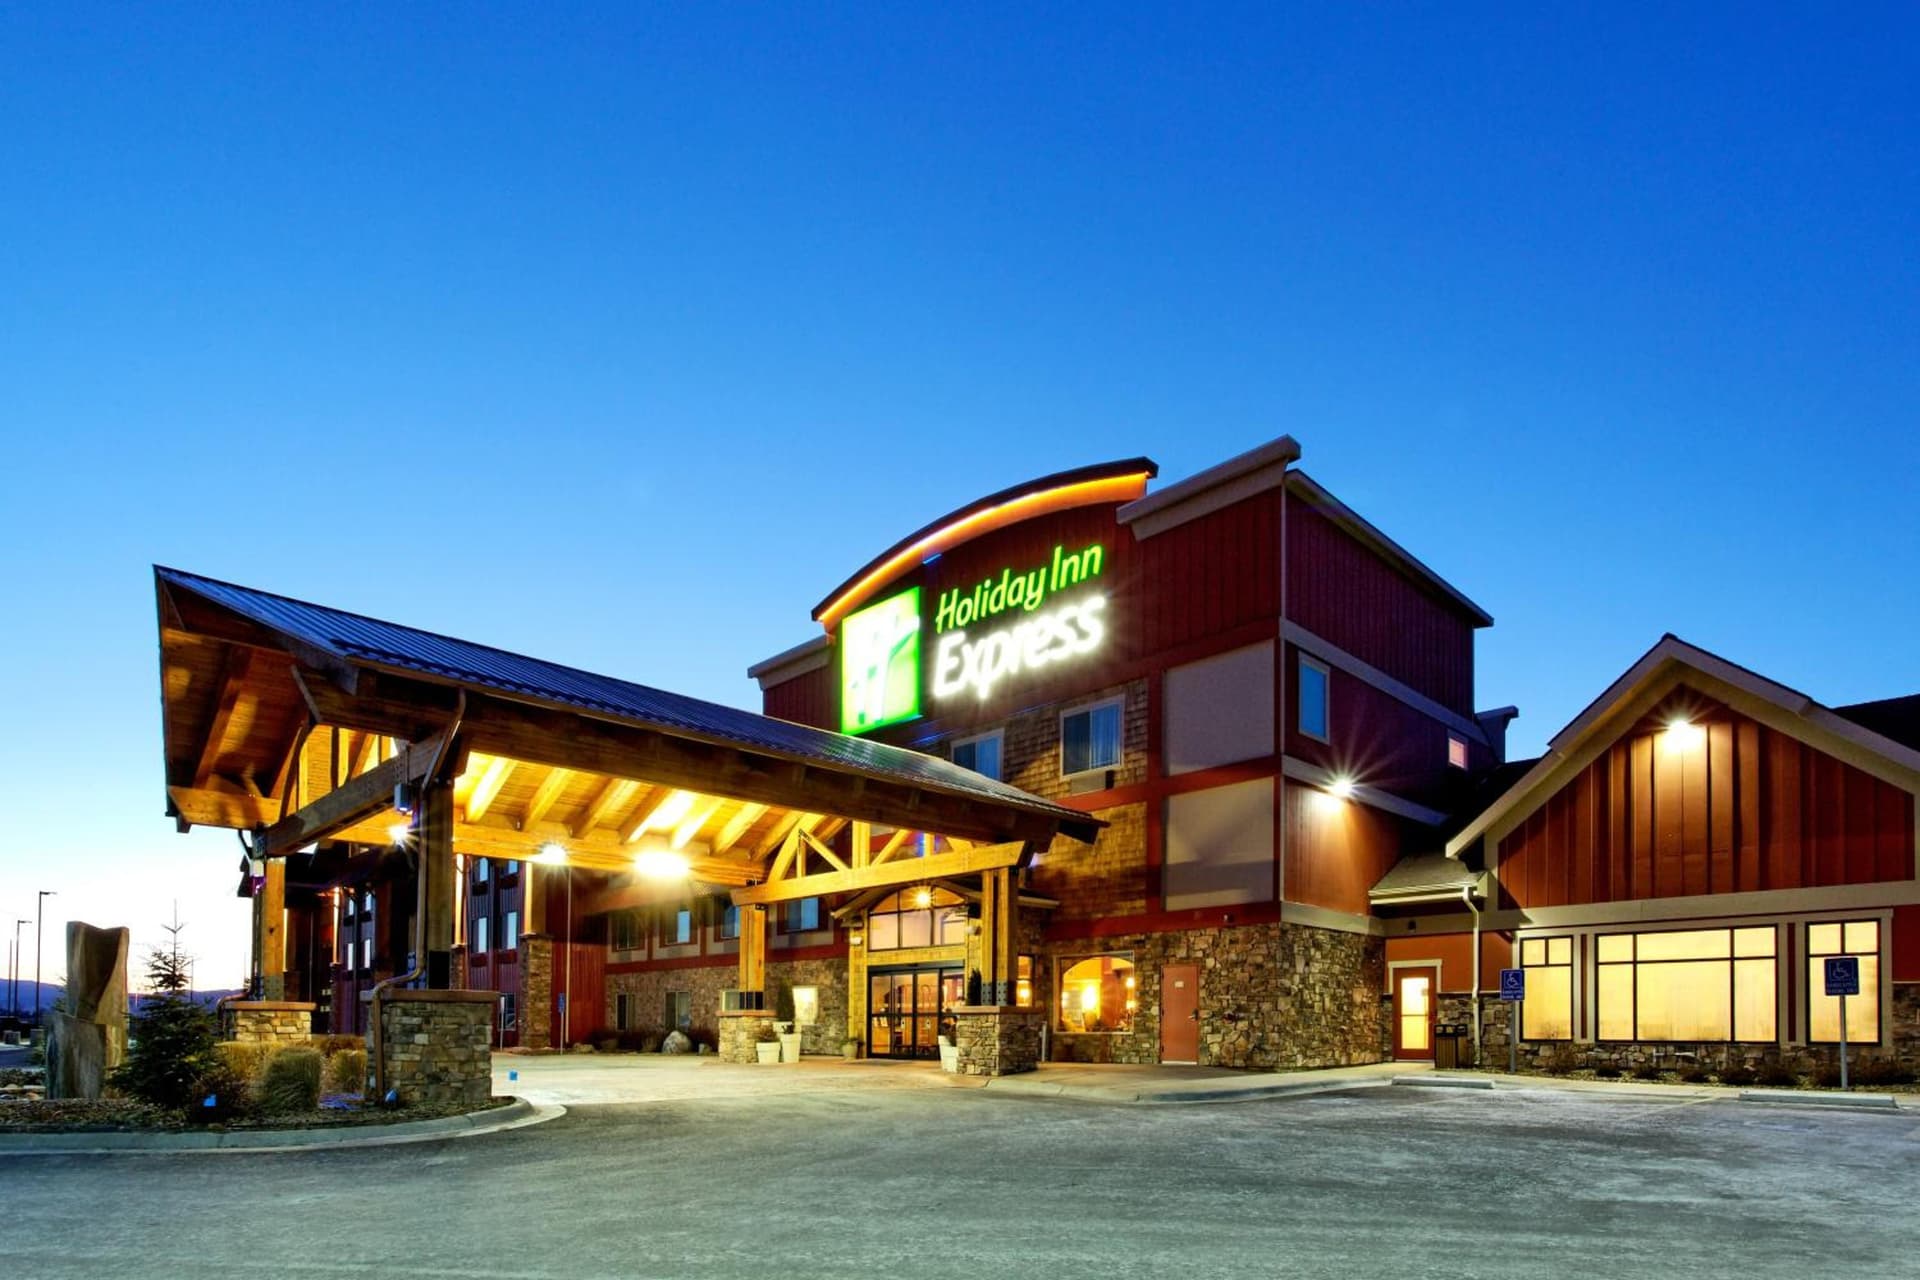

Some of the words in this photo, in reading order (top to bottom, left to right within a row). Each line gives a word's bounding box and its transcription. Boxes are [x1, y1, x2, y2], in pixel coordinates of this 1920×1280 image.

[935, 568, 1047, 634] Holiday
[1050, 544, 1103, 592] Inn
[932, 594, 1106, 700] Express
